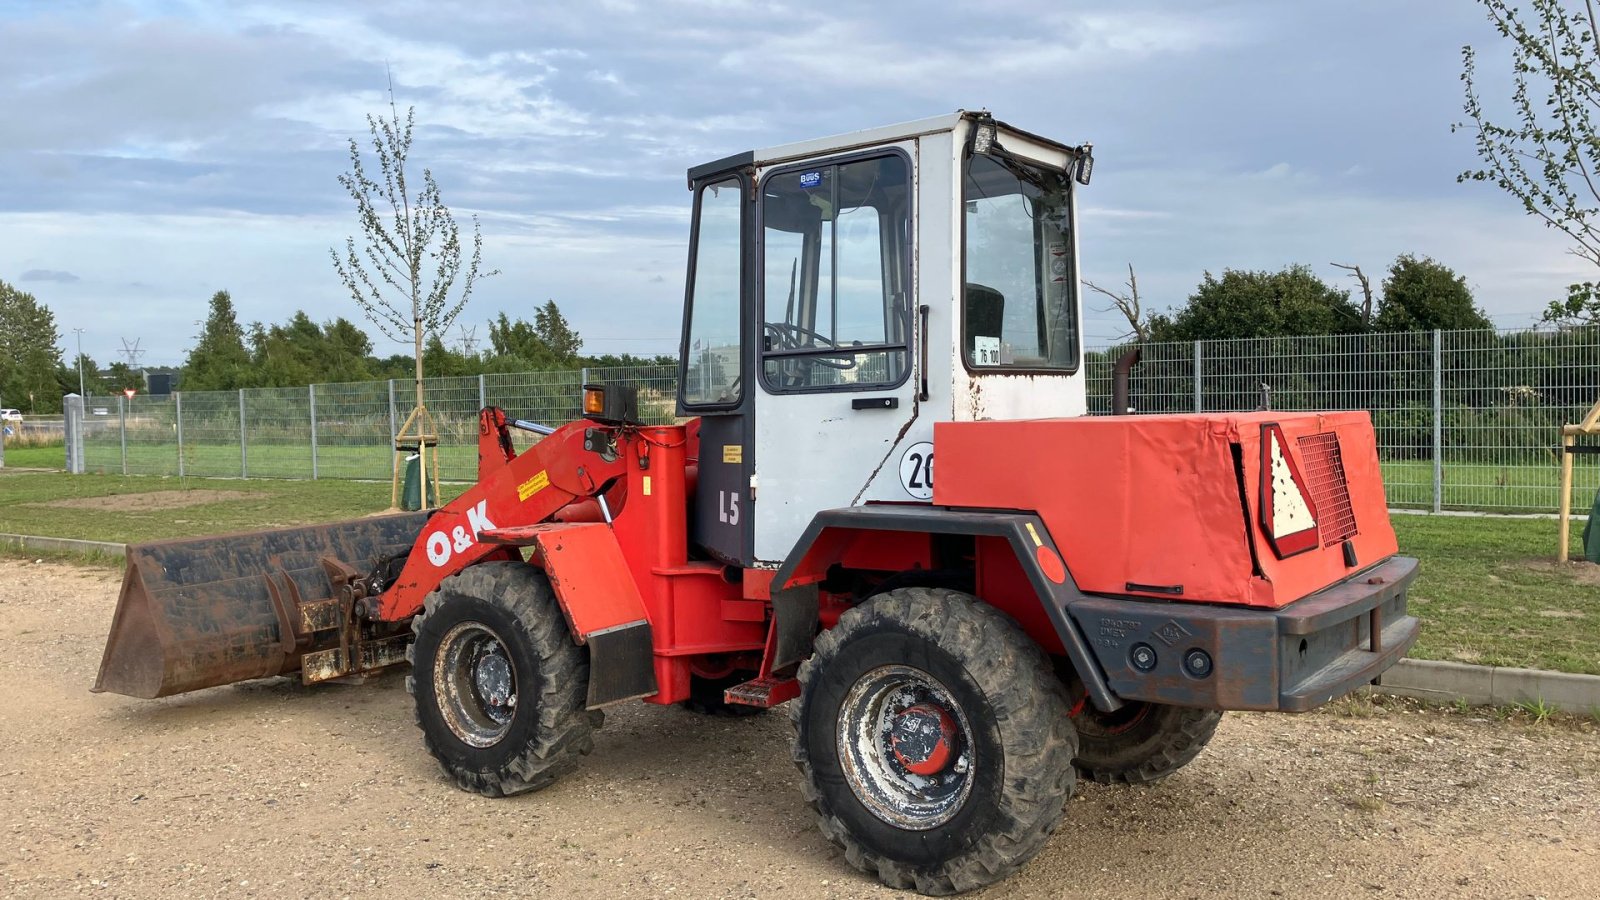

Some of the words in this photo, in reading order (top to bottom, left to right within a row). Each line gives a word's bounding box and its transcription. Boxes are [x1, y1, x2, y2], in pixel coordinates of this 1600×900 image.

[980, 349, 988, 363] 76
[719, 490, 739, 525] L5
[426, 499, 498, 567] O&K
